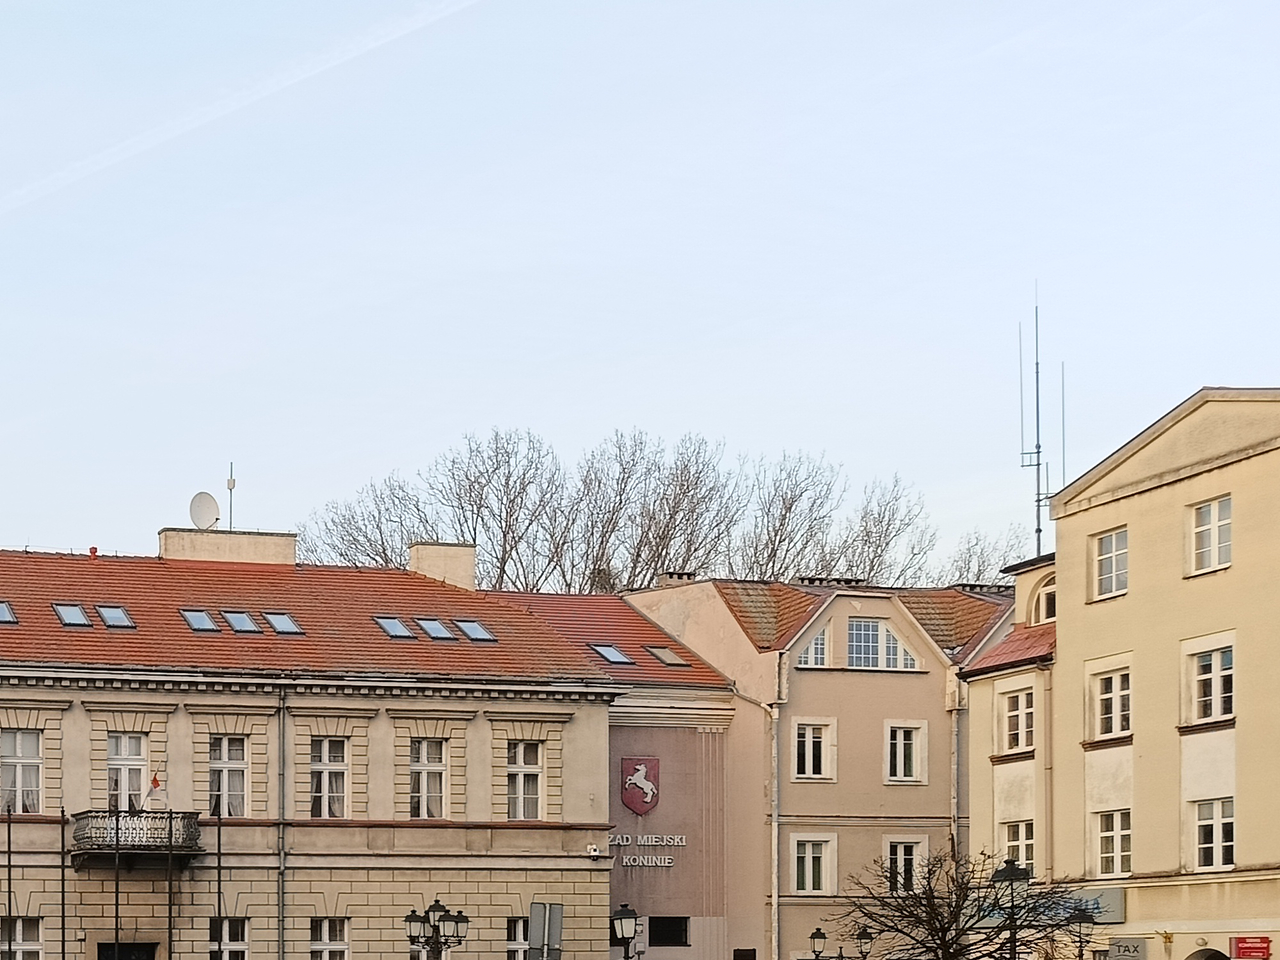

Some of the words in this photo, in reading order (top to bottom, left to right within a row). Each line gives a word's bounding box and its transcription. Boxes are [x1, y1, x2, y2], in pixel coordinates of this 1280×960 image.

[637, 834, 687, 846] MIEJSKI
[622, 855, 675, 867] KONINIE
[1115, 944, 1140, 954] TAX
